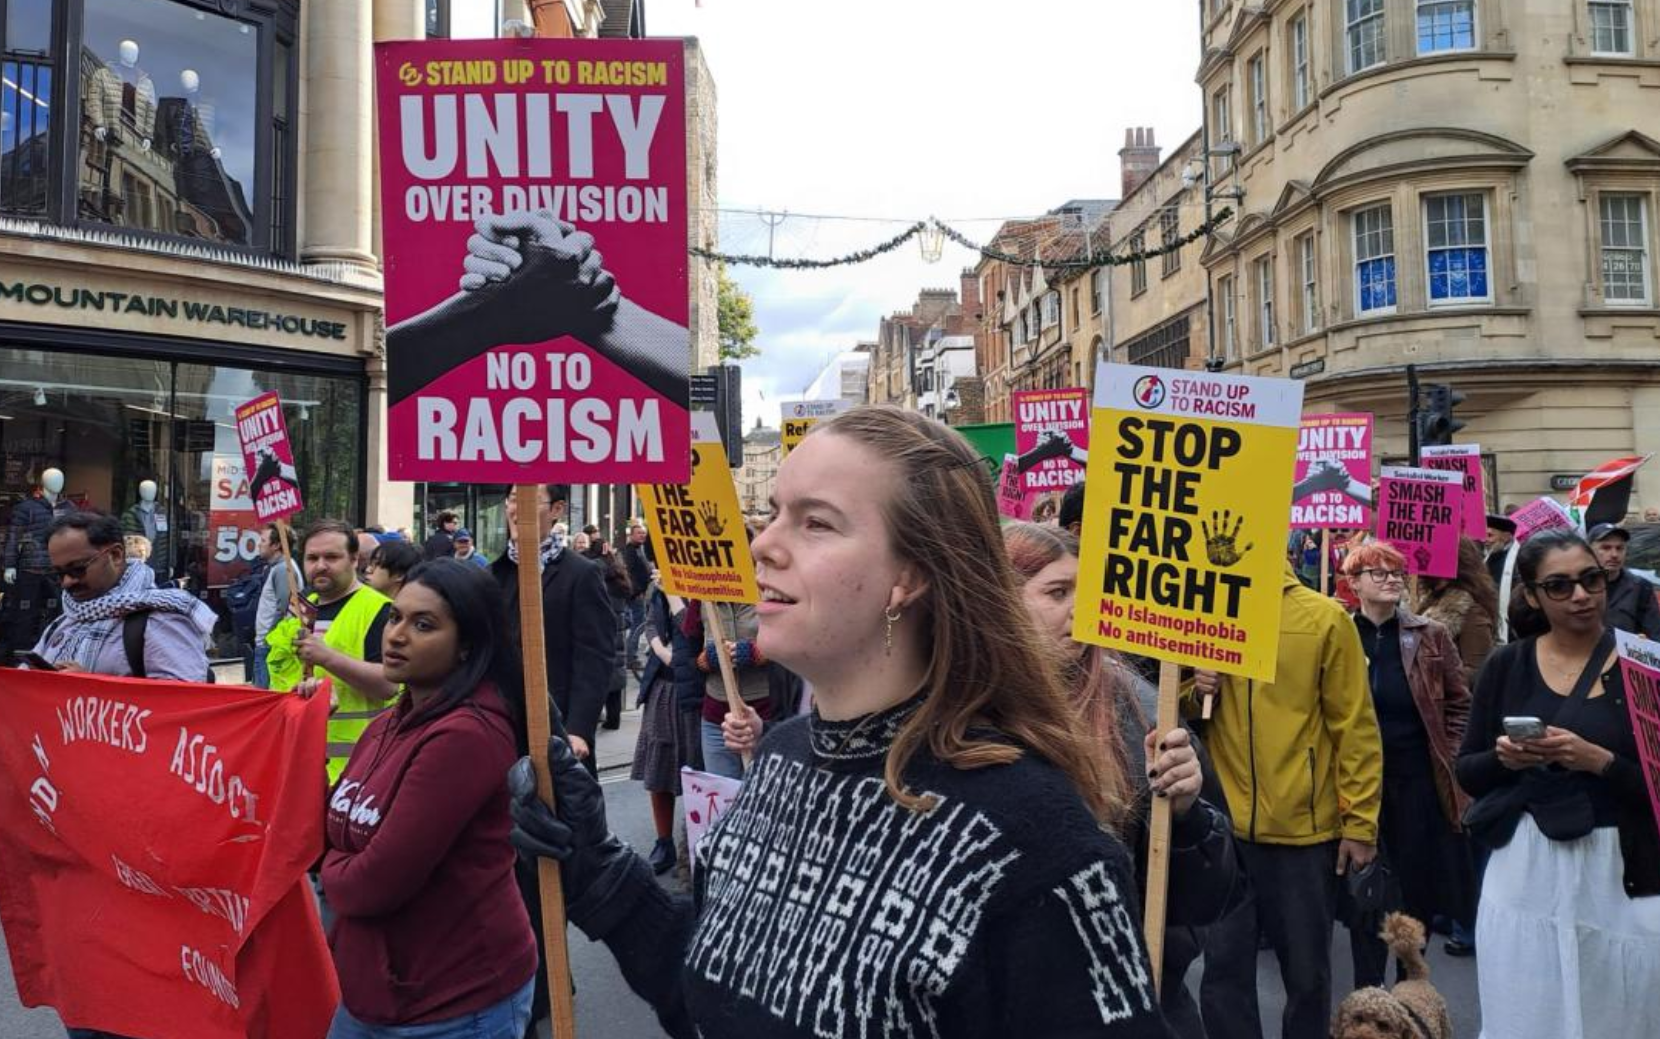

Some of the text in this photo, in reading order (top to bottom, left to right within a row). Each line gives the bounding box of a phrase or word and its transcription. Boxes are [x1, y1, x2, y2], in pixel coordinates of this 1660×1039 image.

[427, 60, 667, 85] STAND UP TO RACISM
[400, 93, 666, 179] UNITY
[405, 185, 668, 222] OVER DIVISION
[0, 282, 346, 340] MOUNTAIN WAREHOUSE
[486, 352, 591, 390] NO TO
[1171, 379, 1249, 400] STAND UP
[1020, 399, 1082, 422] UNITY
[1171, 395, 1255, 418] TO RACISM
[239, 405, 279, 443] UNITY
[417, 397, 664, 463] RACISM
[1116, 417, 1241, 470] STOP
[1026, 469, 1085, 487] RACISM
[1043, 459, 1068, 470] NO TO
[1394, 470, 1449, 481] Socialist Worker
[1428, 458, 1468, 474] SMASH
[256, 487, 297, 518] RACISM
[1114, 463, 1201, 514] THE
[1312, 493, 1342, 504] NO TO
[1389, 481, 1445, 504] SMASH
[656, 507, 700, 537] FAR
[1291, 505, 1363, 524] RACISM
[1388, 501, 1452, 525] THE FAR
[1108, 507, 1192, 562] FAR
[1387, 521, 1435, 543] RIGHT
[663, 537, 734, 568] RIGHT
[670, 566, 682, 578] No
[674, 580, 686, 592] No
[1103, 554, 1251, 618] RIGHT
[1099, 599, 1246, 643] No Islamophobia
[1098, 620, 1242, 664] No antisemitism
[56, 697, 152, 753] WORKERS
